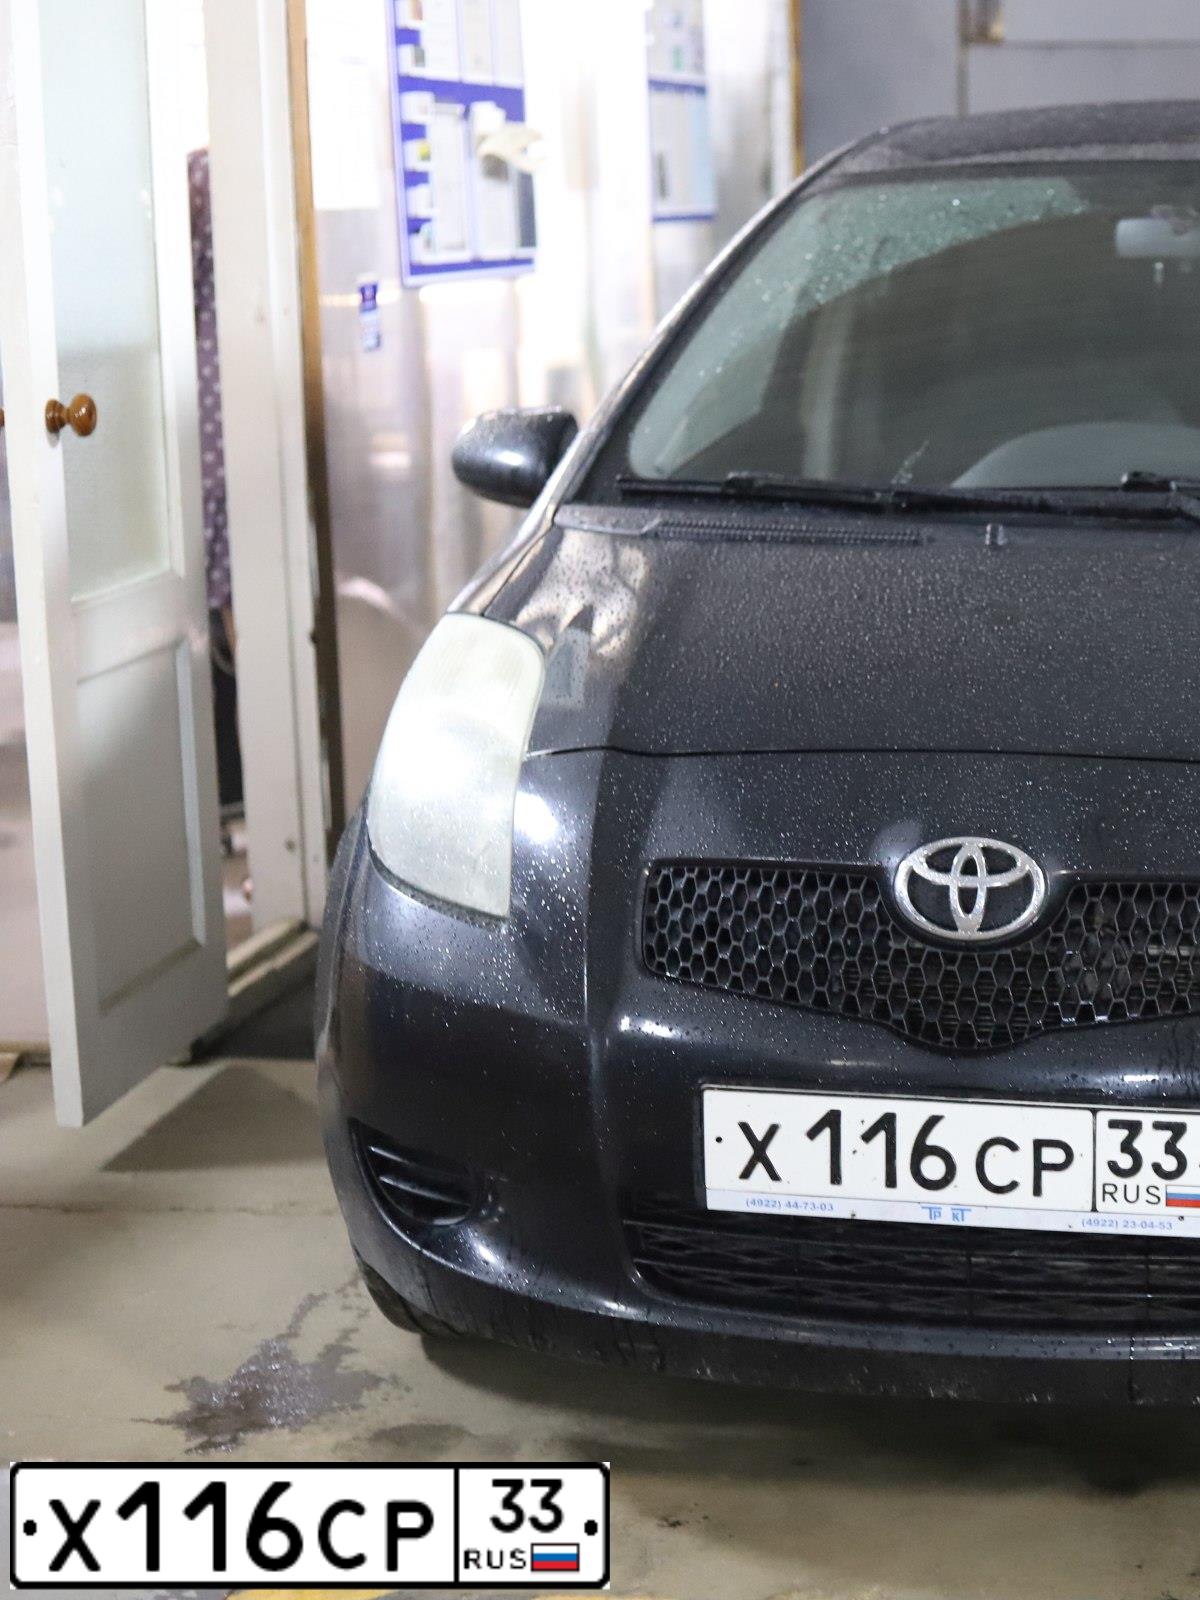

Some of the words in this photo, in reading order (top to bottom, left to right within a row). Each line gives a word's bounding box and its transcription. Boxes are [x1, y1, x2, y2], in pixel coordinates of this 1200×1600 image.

[1107, 1119, 1187, 1181] 33
[1102, 1183, 1161, 1205] RUS
[745, 1197, 781, 1209] (4922)
[1081, 1217, 1118, 1229] (4922)
